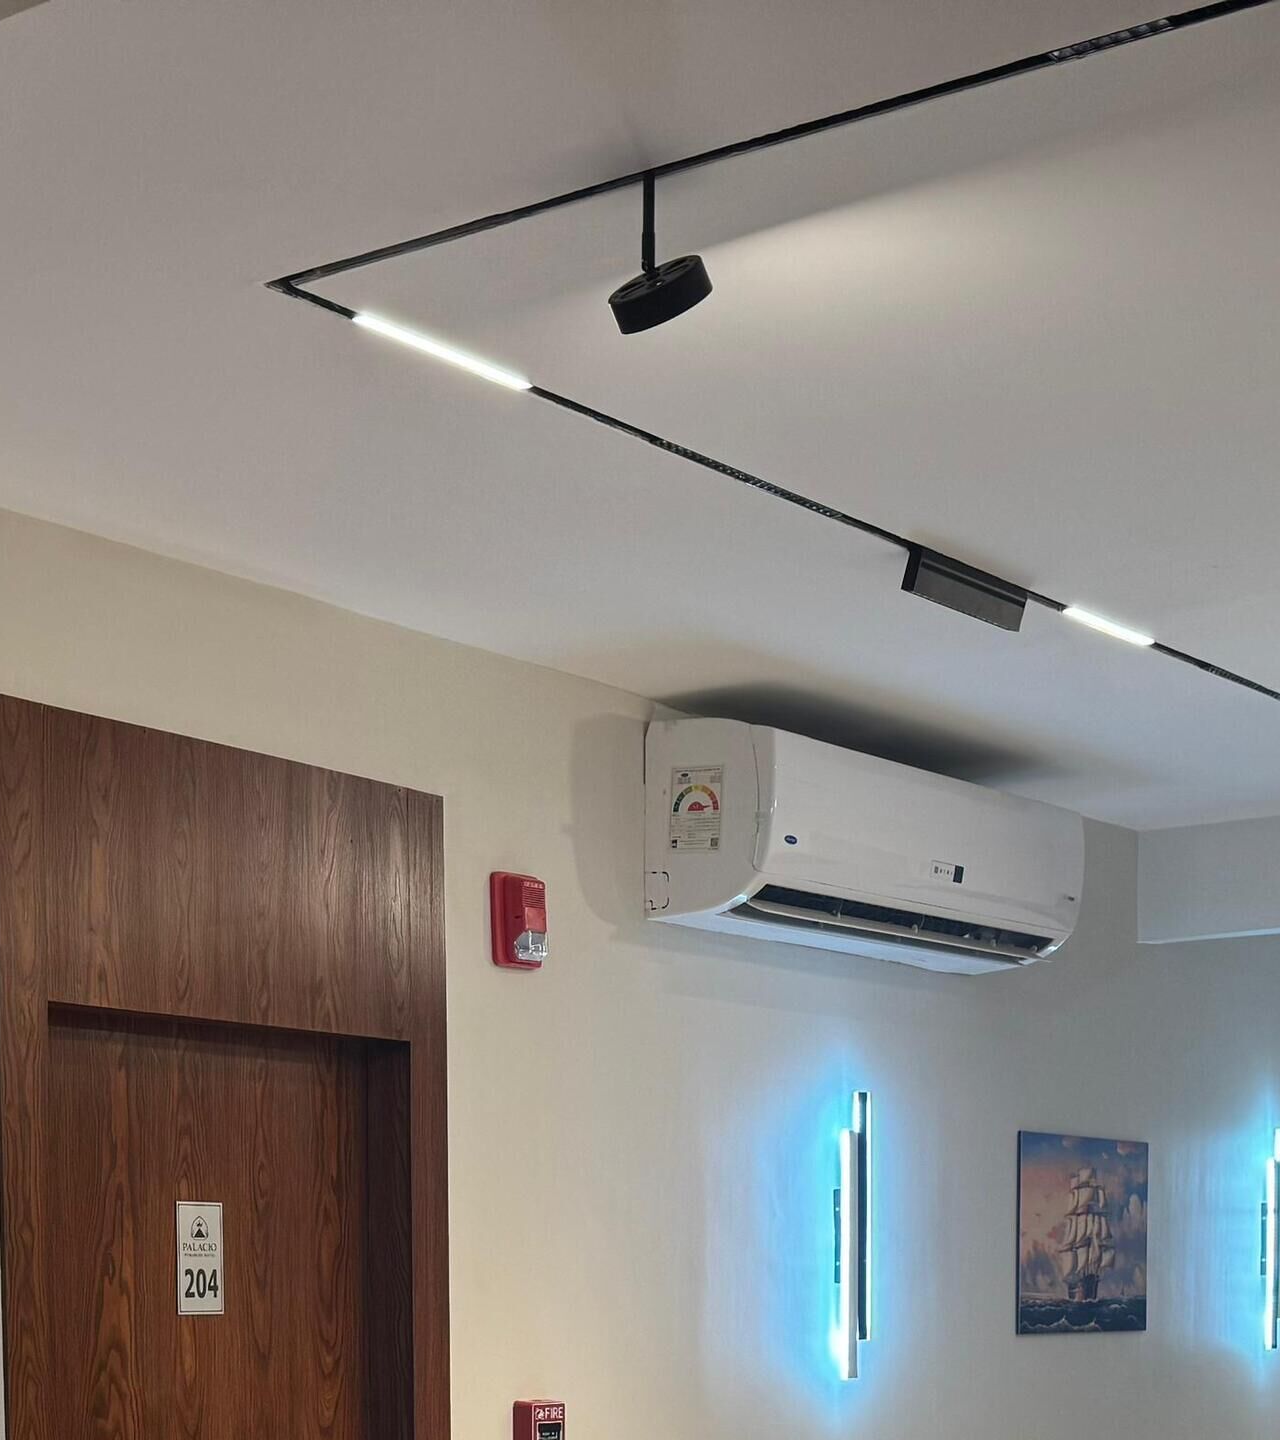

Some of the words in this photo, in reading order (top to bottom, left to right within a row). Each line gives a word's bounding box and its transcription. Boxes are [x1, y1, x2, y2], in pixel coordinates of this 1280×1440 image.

[182, 1242, 217, 1252] PALACIO
[184, 1268, 219, 1298] 204
[544, 1406, 564, 1419] FIRE
